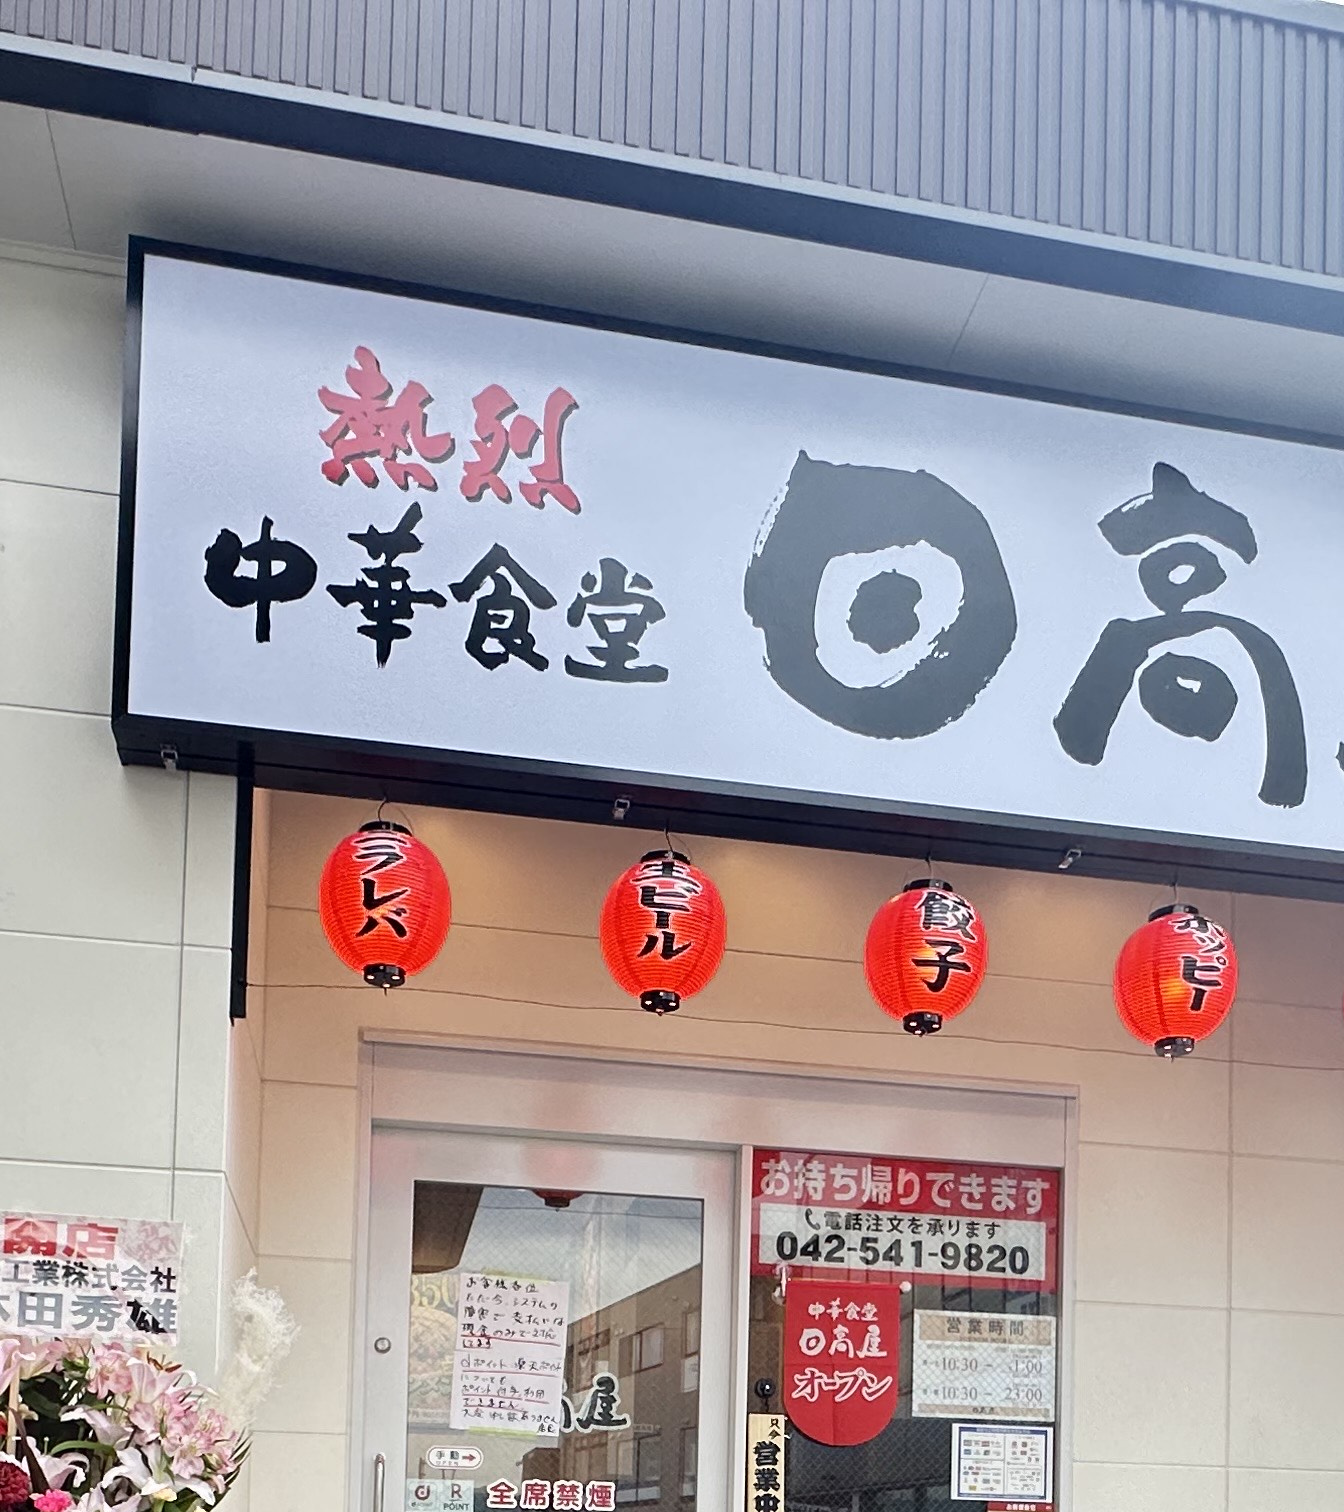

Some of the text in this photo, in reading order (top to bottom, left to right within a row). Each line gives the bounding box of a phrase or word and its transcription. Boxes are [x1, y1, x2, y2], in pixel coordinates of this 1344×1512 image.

[318, 346, 581, 515] 熱烈
[204, 502, 669, 682] 中華食堂
[631, 860, 700, 960] 生ビール
[916, 890, 977, 992] 餃子
[760, 1158, 1051, 1215] お持ち帰りできます
[824, 1211, 1002, 1240] 電話注文を承ります
[776, 1231, 1030, 1275] 042-541-9820
[808, 1297, 878, 1321] 中華食堂
[947, 1317, 1024, 1336] 営業時間
[799, 1324, 887, 1358] 日高屋
[791, 1367, 893, 1402] オープン
[444, 1503, 470, 1511] POINT
[488, 1480, 613, 1509] 全席禁煙
